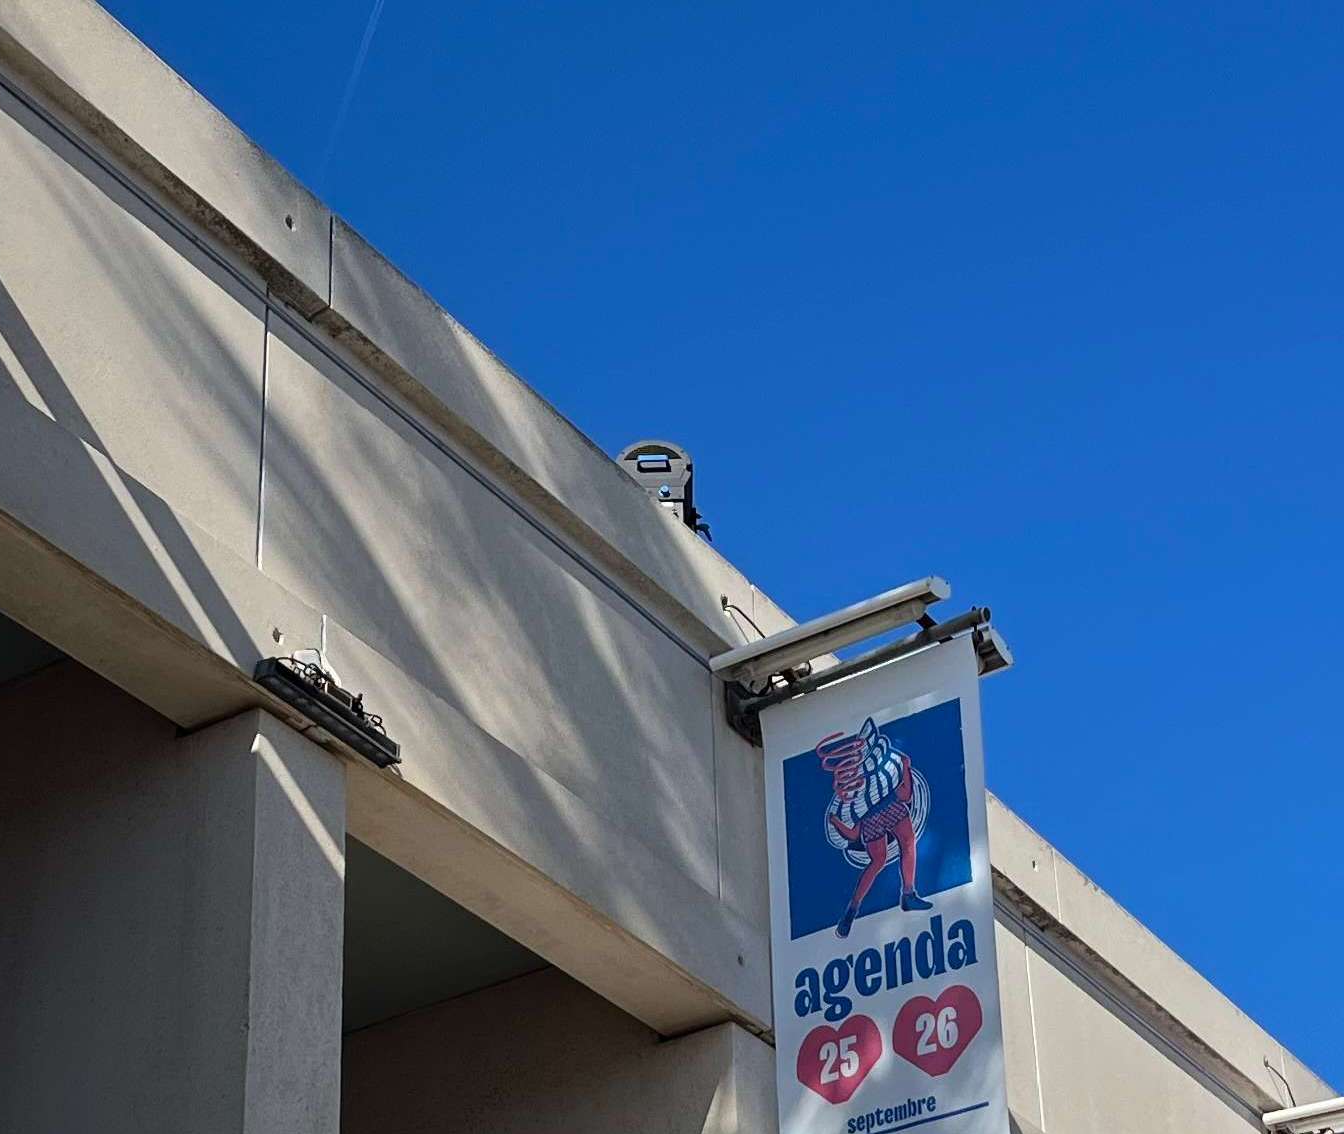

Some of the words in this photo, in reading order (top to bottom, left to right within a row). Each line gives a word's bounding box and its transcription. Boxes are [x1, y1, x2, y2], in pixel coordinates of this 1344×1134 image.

[794, 915, 978, 1022] agenda
[818, 1034, 860, 1085] 25
[915, 1006, 958, 1057] 26
[847, 1096, 937, 1134] septembre
